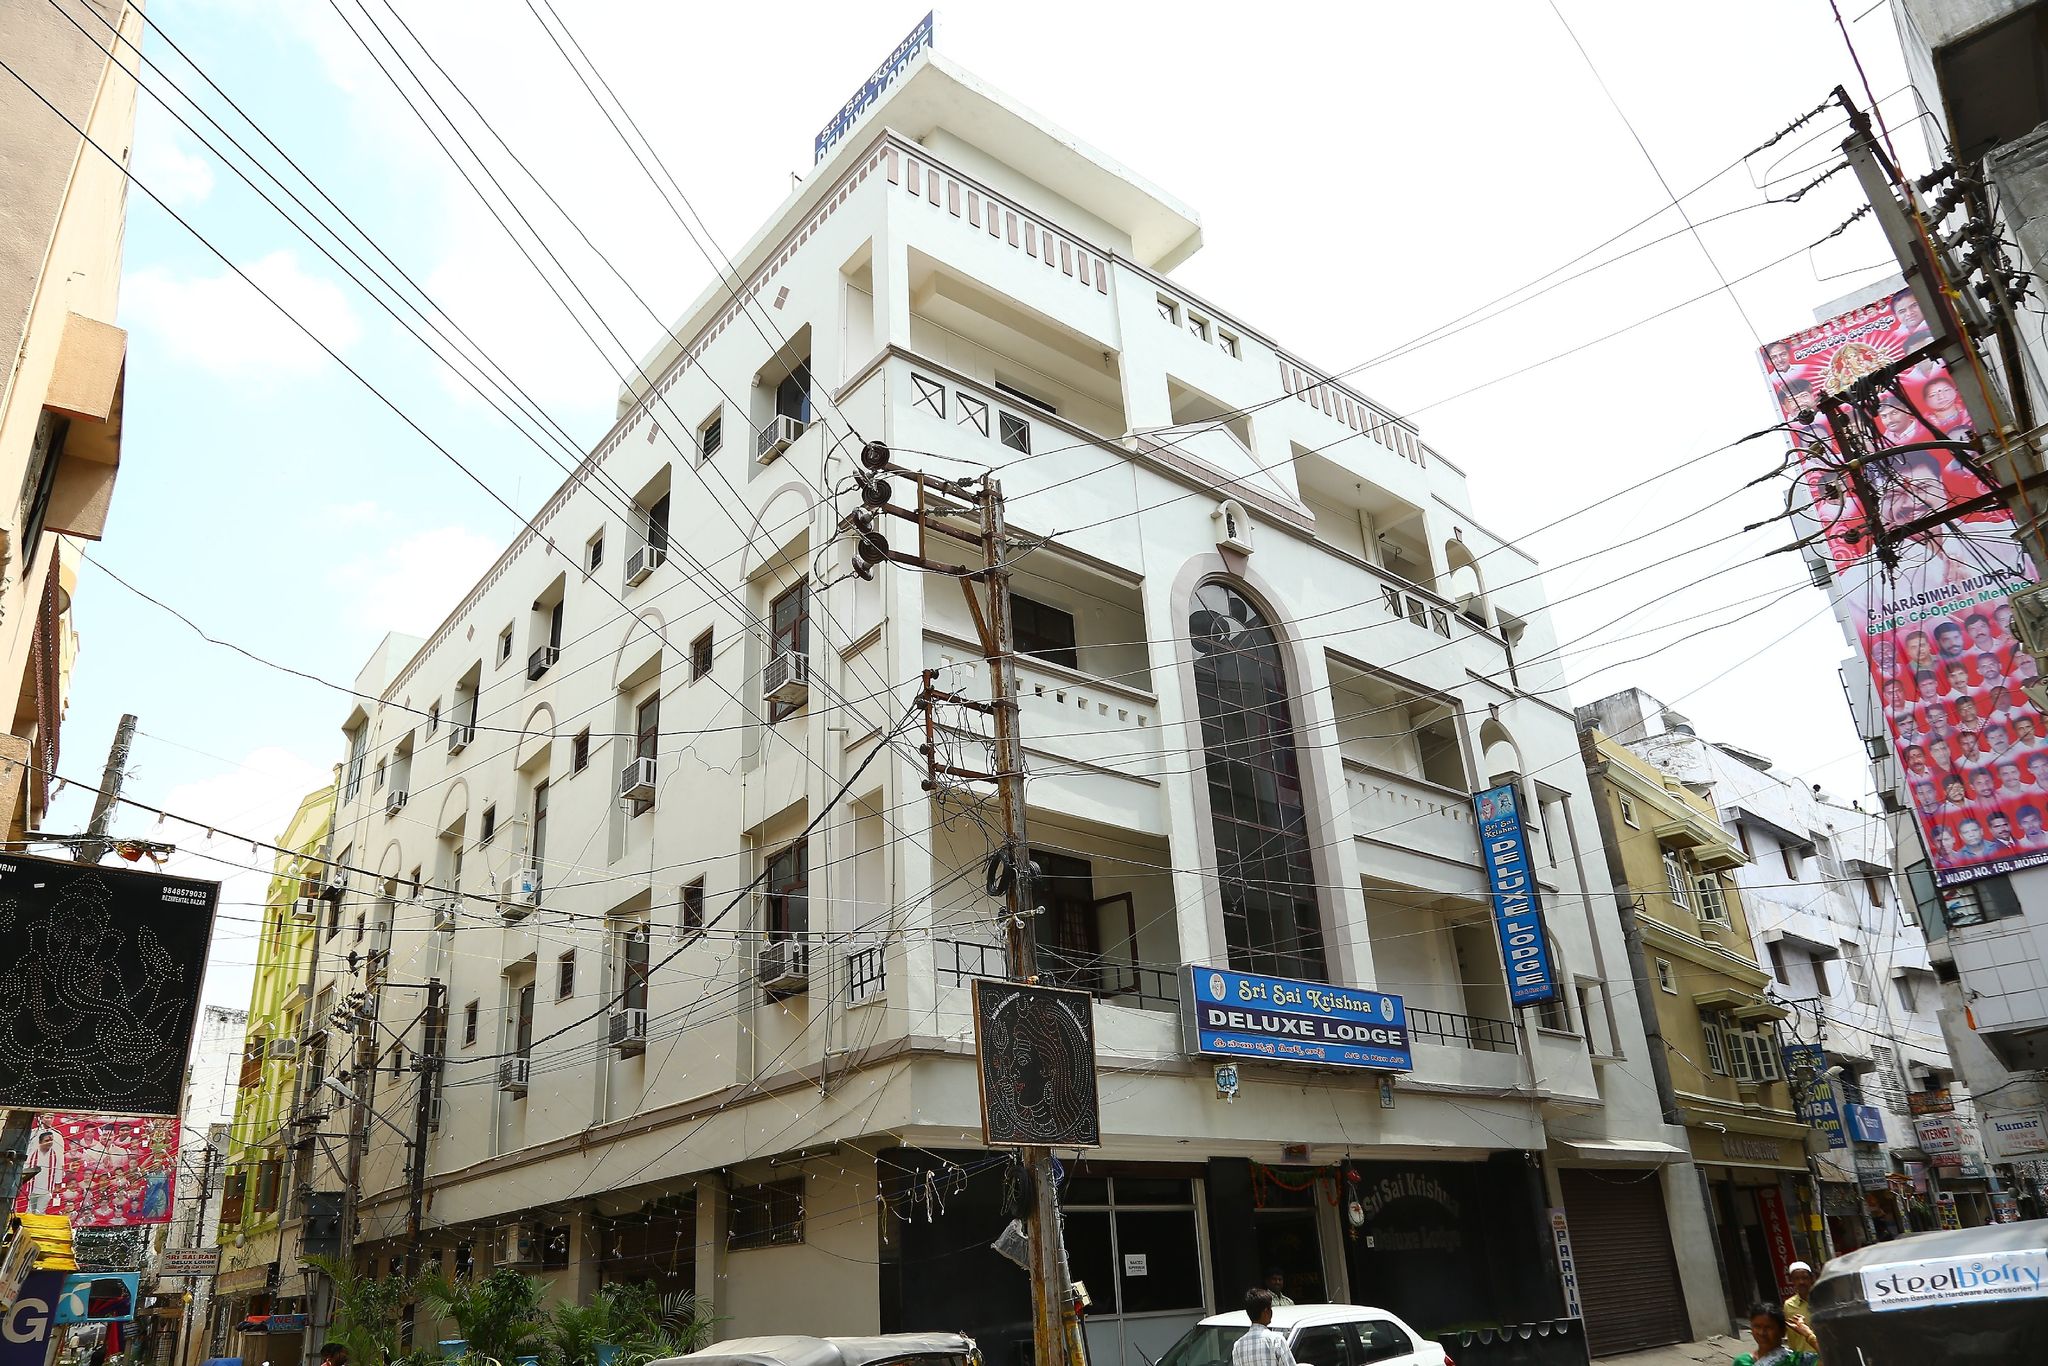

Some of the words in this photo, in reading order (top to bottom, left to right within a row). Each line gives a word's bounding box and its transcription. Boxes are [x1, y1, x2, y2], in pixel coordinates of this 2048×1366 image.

[821, 113, 841, 143] Sri
[845, 84, 867, 117] Sai
[870, 23, 926, 86] Krishna
[1866, 616, 1905, 635] GHMC
[1909, 596, 1976, 622] Co-Option
[1882, 584, 1961, 616] NARASIMHA
[1491, 839, 1530, 917] DELUXE
[1944, 870, 1973, 884] WARD
[1507, 922, 1545, 987] LODGE
[1238, 980, 1267, 1001] Sri
[1272, 984, 1302, 1006] Sai
[1306, 989, 1373, 1013] Krishna
[1207, 1009, 1316, 1037] DELUXE
[1323, 1022, 1403, 1046] LODGE
[1800, 1101, 1835, 1118] MBA
[1994, 1120, 2039, 1132] kumar
[1919, 1127, 1951, 1141] INTERNET
[1362, 1184, 1384, 1218] Sri
[1380, 1173, 1406, 1202] Sai
[1910, 1293, 1936, 1302] Basket
[1945, 1289, 1982, 1299] Hardware
[1983, 1285, 2033, 1295] Accessories
